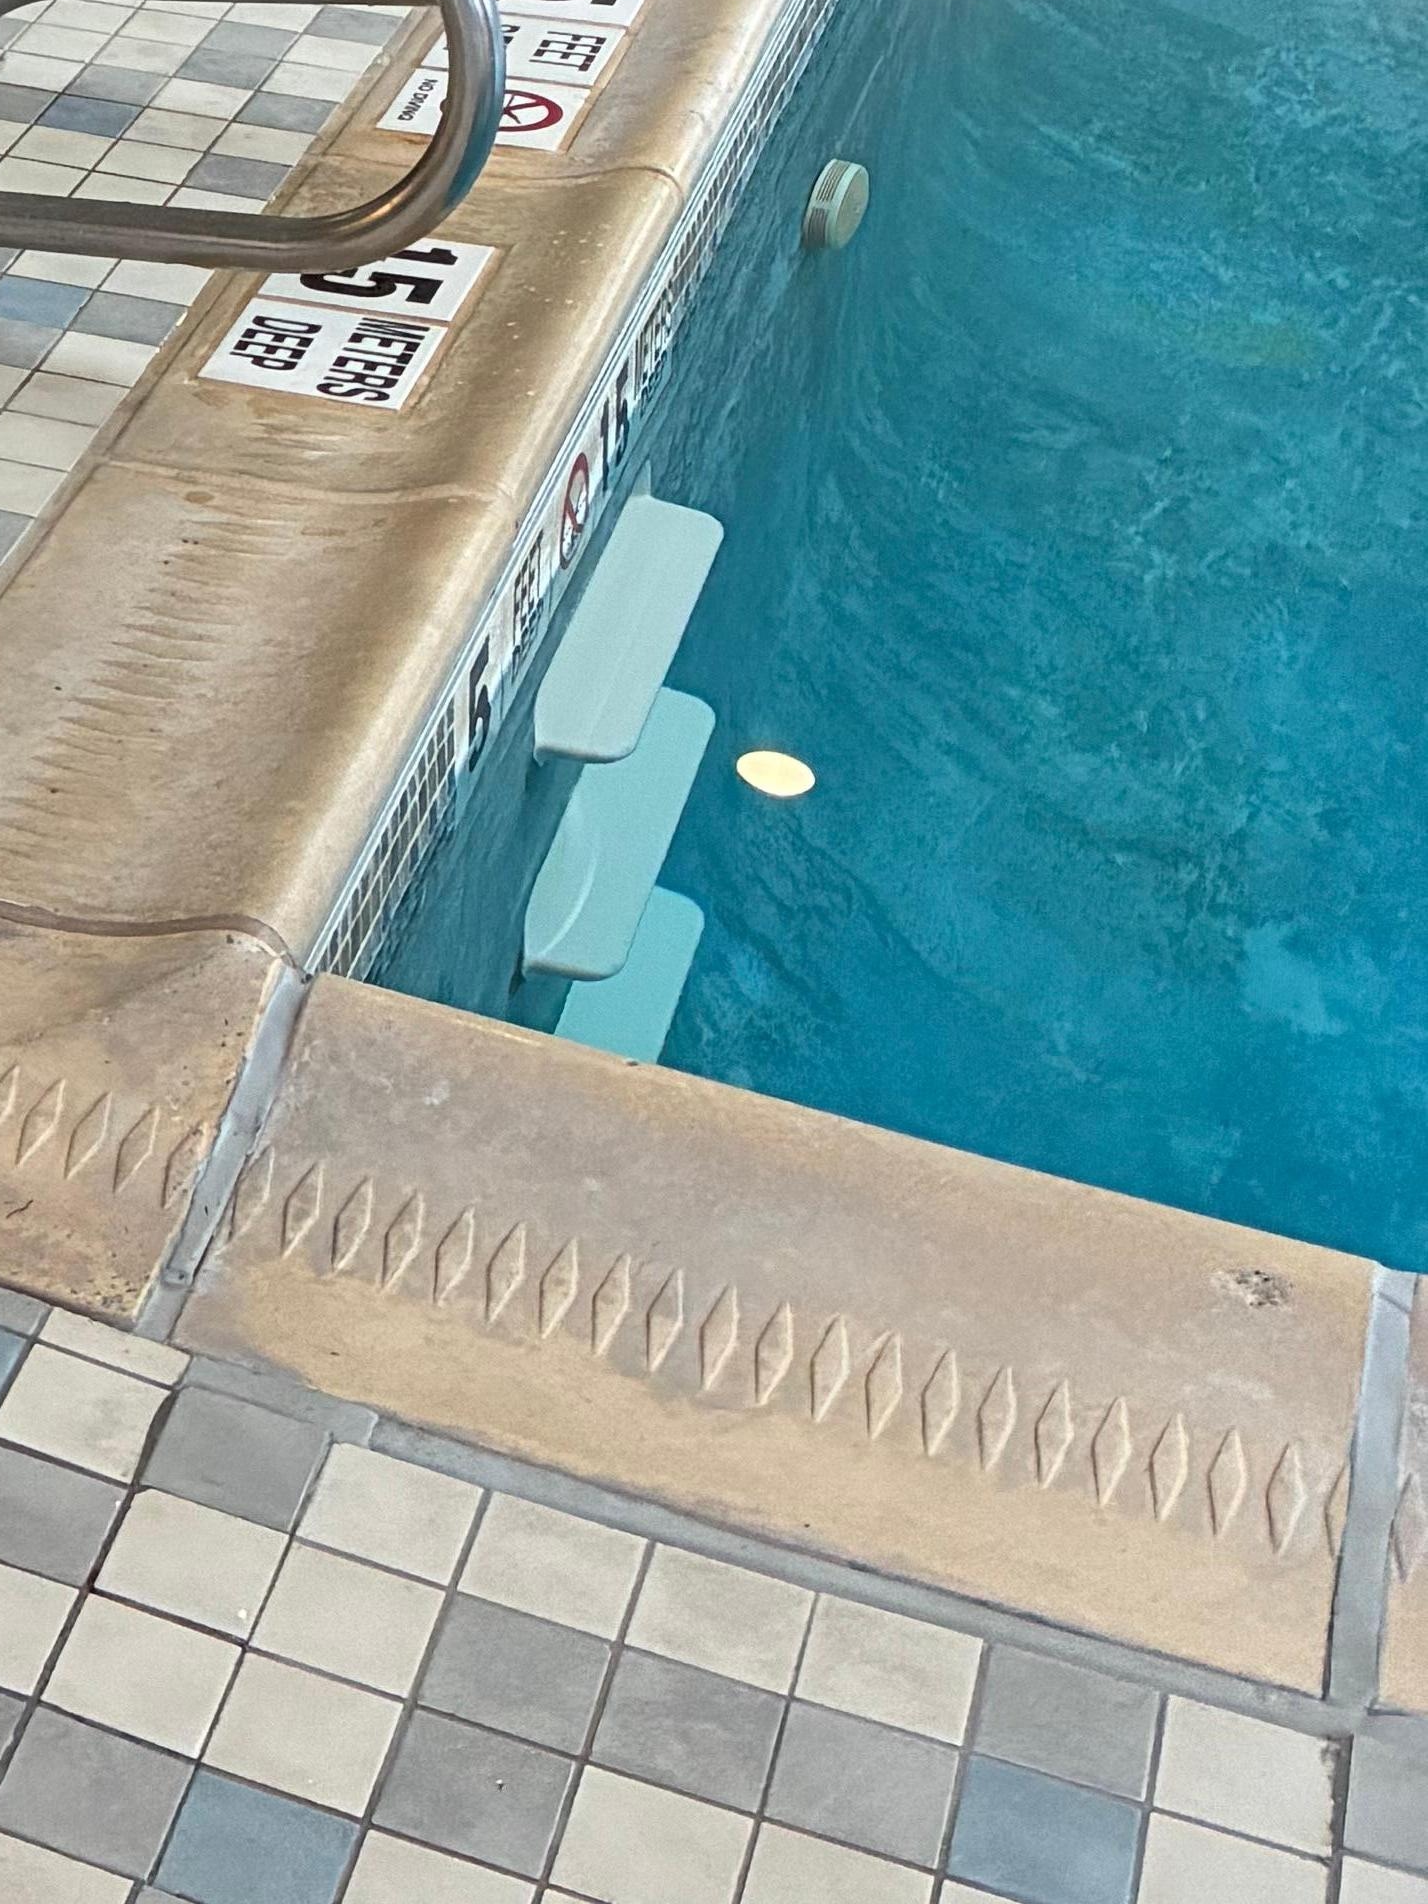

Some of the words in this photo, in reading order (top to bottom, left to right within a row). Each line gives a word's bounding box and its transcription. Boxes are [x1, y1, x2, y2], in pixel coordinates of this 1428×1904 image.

[529, 31, 607, 72] FEET
[397, 91, 429, 121] DIVING
[424, 78, 438, 92] NO
[229, 315, 323, 371] DEEP
[316, 317, 430, 402] METERS
[468, 635, 492, 773] 5
